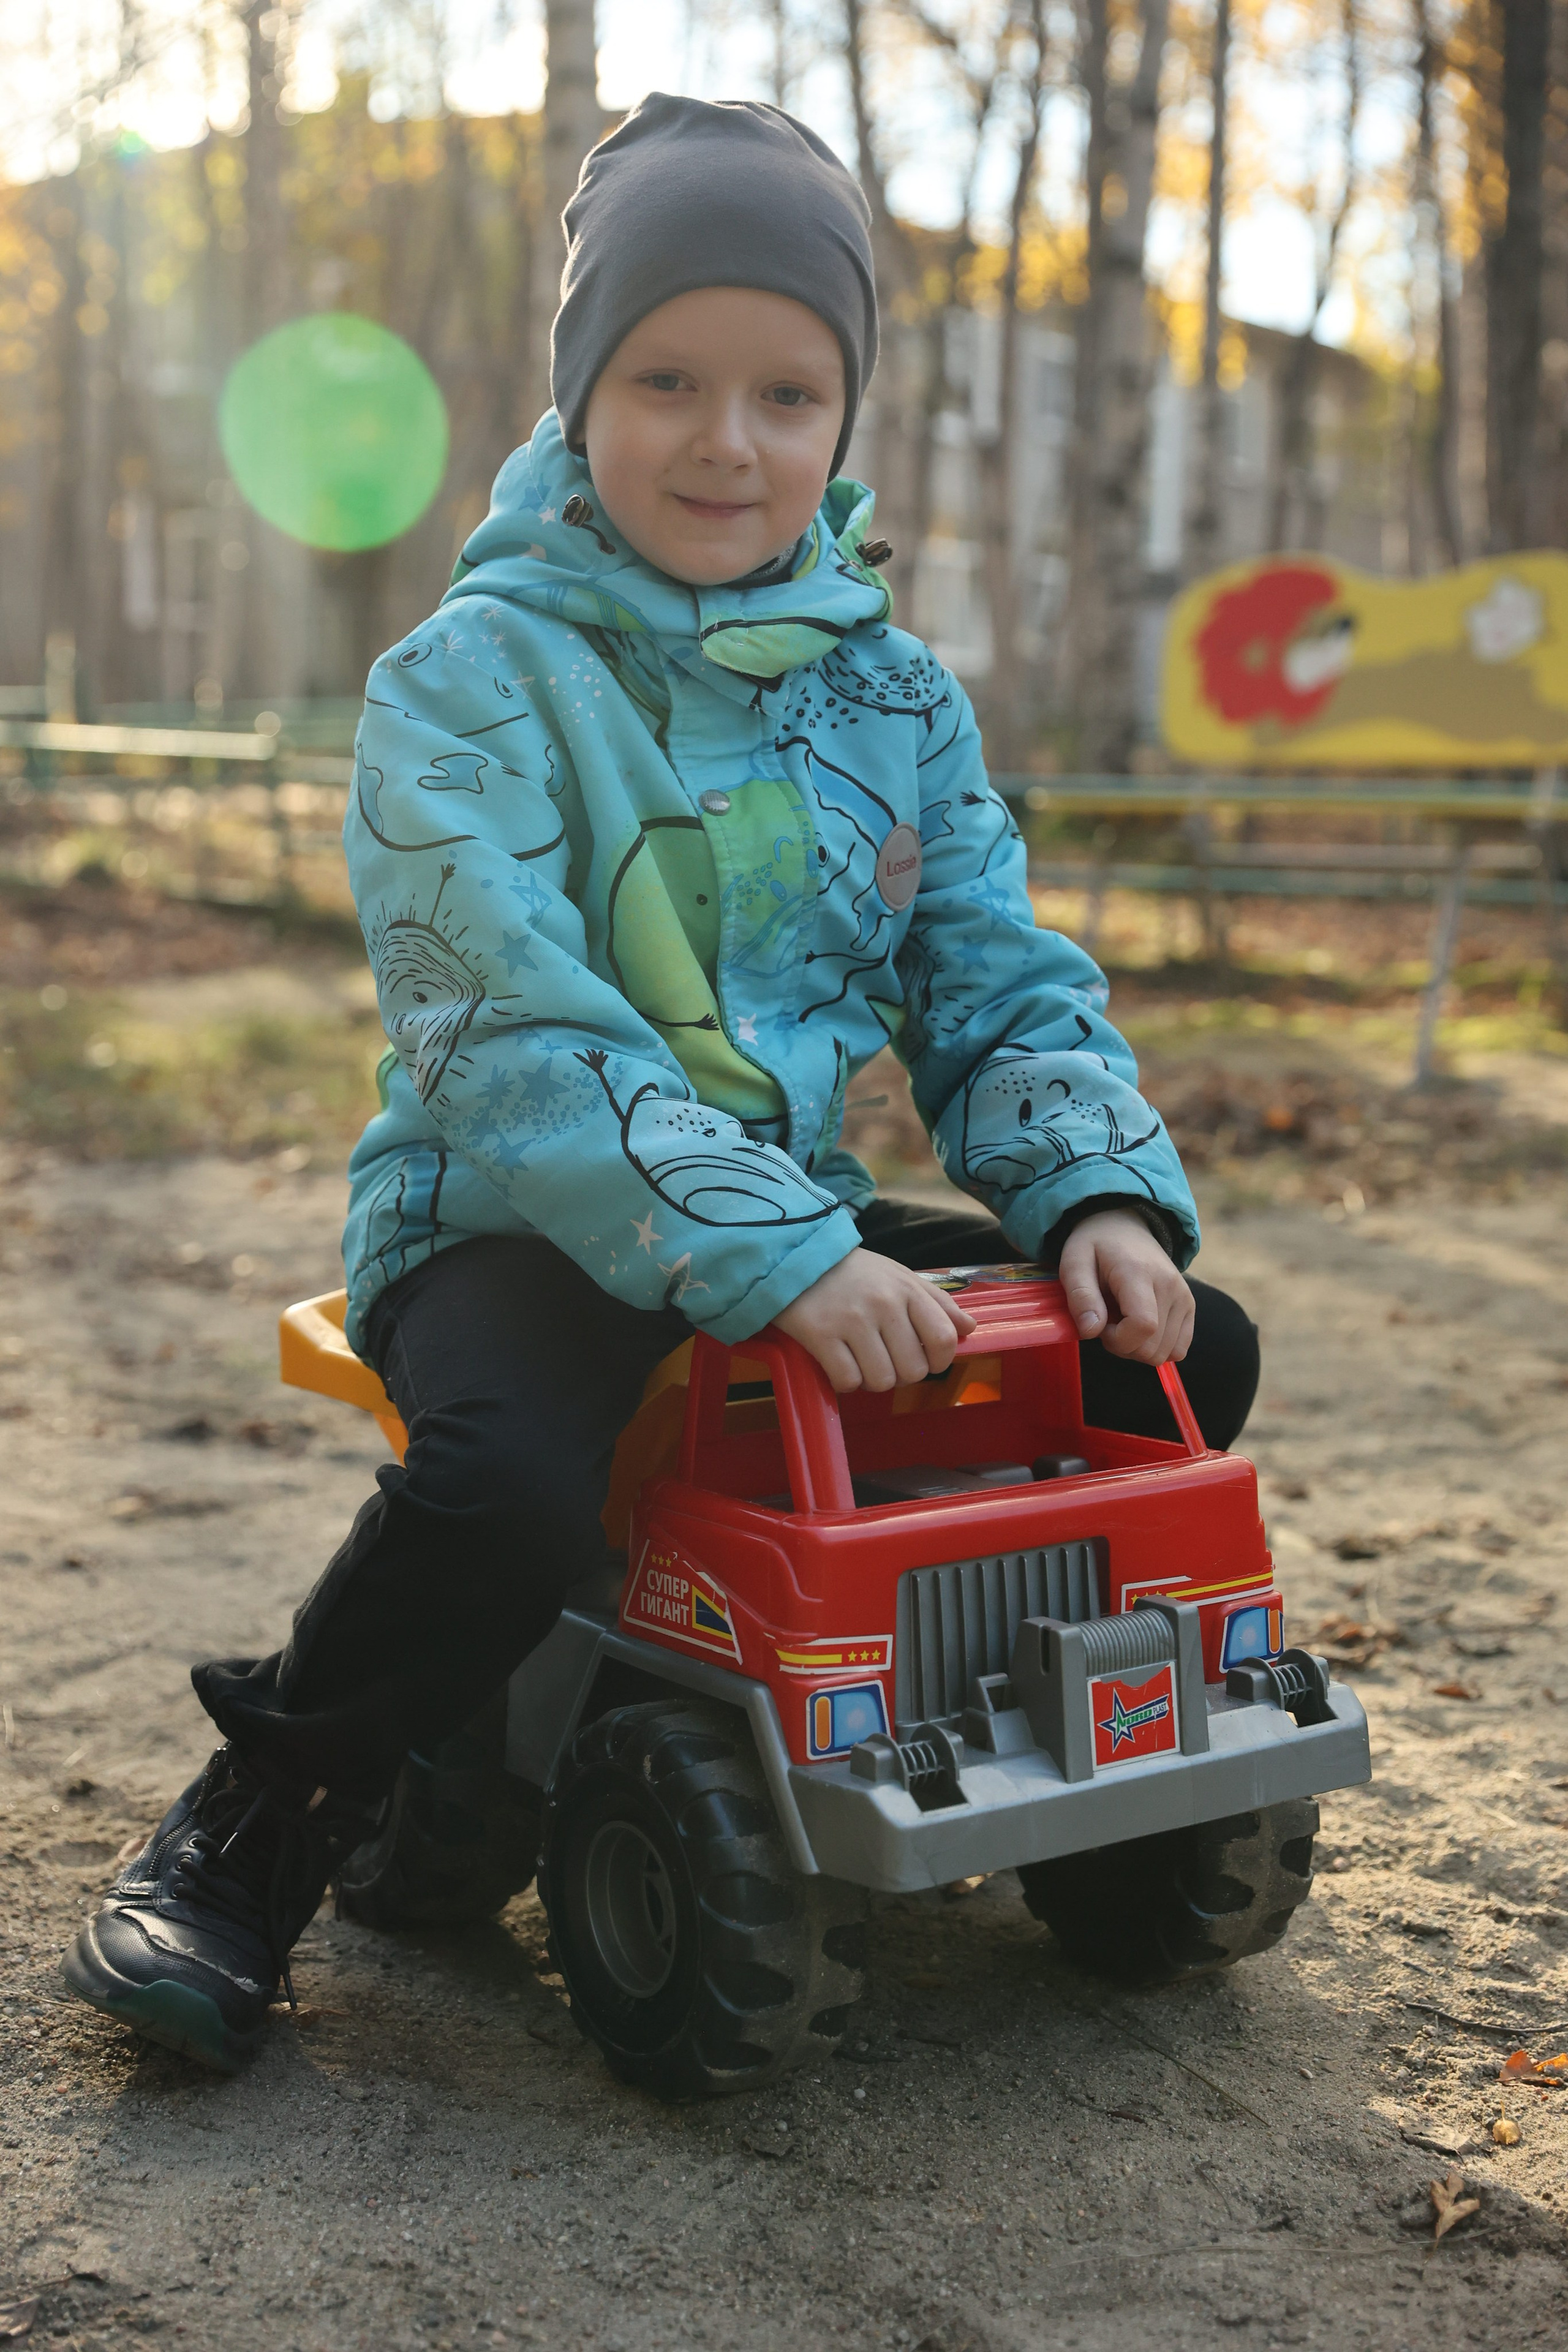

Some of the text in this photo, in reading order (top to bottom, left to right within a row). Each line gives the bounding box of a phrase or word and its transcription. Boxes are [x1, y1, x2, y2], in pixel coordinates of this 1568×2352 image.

[887, 854, 916, 876] Lossie
[647, 1569, 689, 1599] СУПЕР
[641, 1591, 689, 1625] ГИГАНТ
